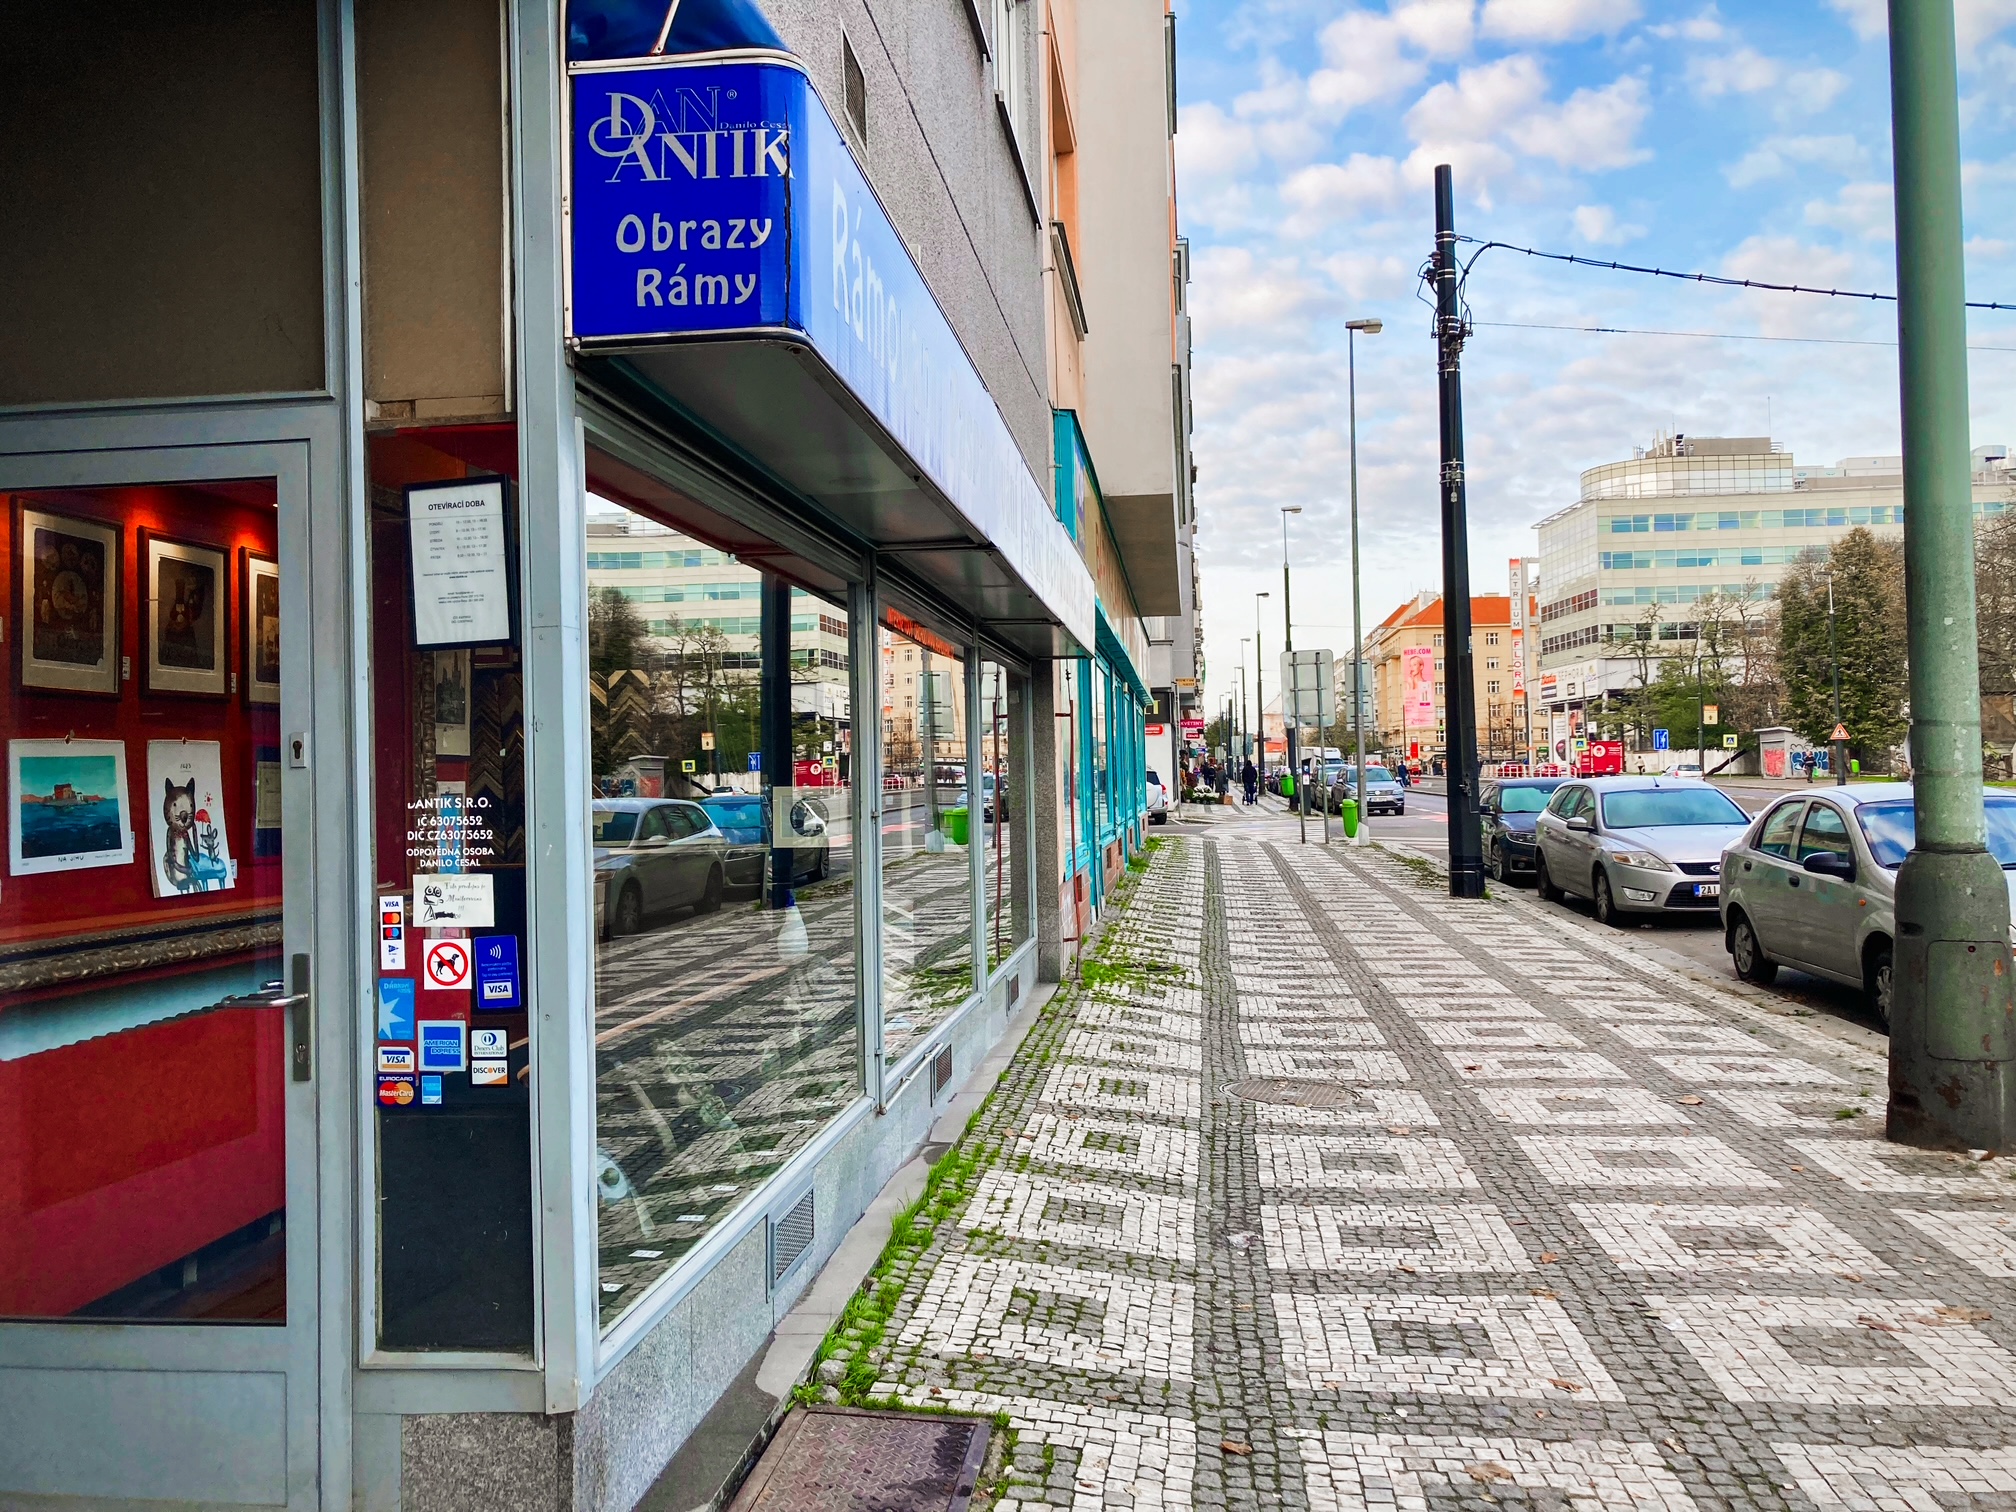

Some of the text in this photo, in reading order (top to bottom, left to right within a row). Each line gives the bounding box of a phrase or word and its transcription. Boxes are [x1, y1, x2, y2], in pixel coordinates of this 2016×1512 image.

[720, 120, 757, 129] Danilo
[605, 128, 796, 183] ANTIK
[616, 212, 772, 253] Obrazy
[636, 263, 757, 307] Rámy
[428, 499, 486, 511] OTEVÍRACÍ DOBA
[1512, 571, 1520, 628] ATRIUM
[1403, 648, 1432, 656] HEBE.COM
[1514, 640, 1523, 689] FLORA
[455, 796, 492, 808] S.R.O.
[430, 816, 483, 826] 63075652
[407, 828, 494, 841] DIČ CZ63075652
[406, 845, 495, 856] ODPOVĚDNÁ OSOBA
[420, 855, 481, 867] DANILO ČESAL
[488, 984, 509, 994] VISA
[424, 1039, 458, 1047] AMERICAN
[386, 1055, 406, 1064] VISA
[473, 1066, 506, 1074] DISCOVER
[379, 1089, 413, 1097] MasterCard
